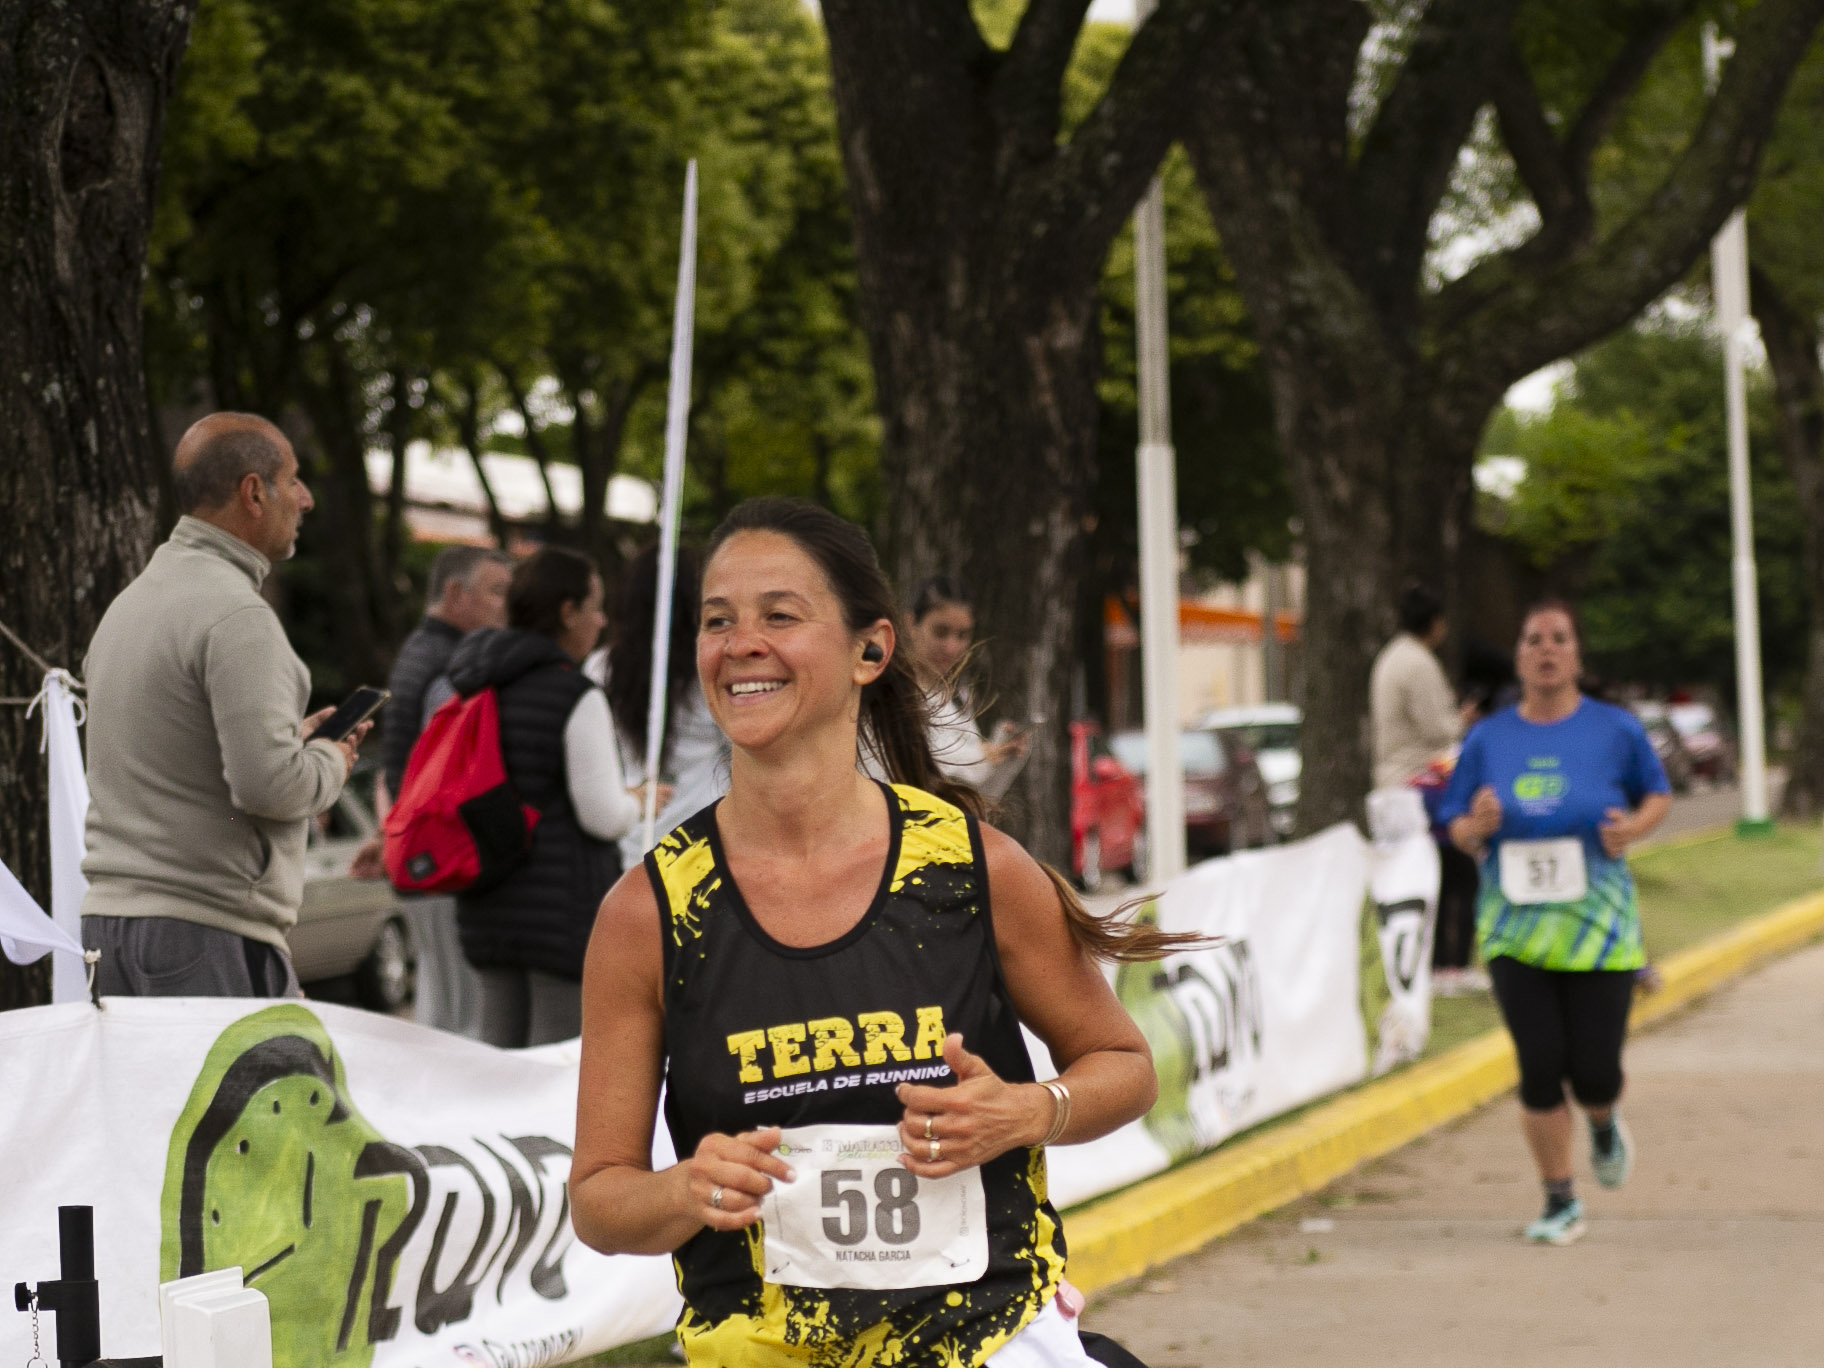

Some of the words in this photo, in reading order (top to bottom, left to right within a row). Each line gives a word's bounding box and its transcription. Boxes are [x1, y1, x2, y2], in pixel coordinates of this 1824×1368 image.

[727, 1006, 947, 1083] TERRA
[744, 1079, 829, 1104] ESCUELA
[833, 1075, 862, 1089] DE
[865, 1065, 950, 1085] RUNNING
[820, 1168, 921, 1247] 58
[836, 1250, 876, 1262] NATACHA
[878, 1250, 911, 1262] GARCIA
